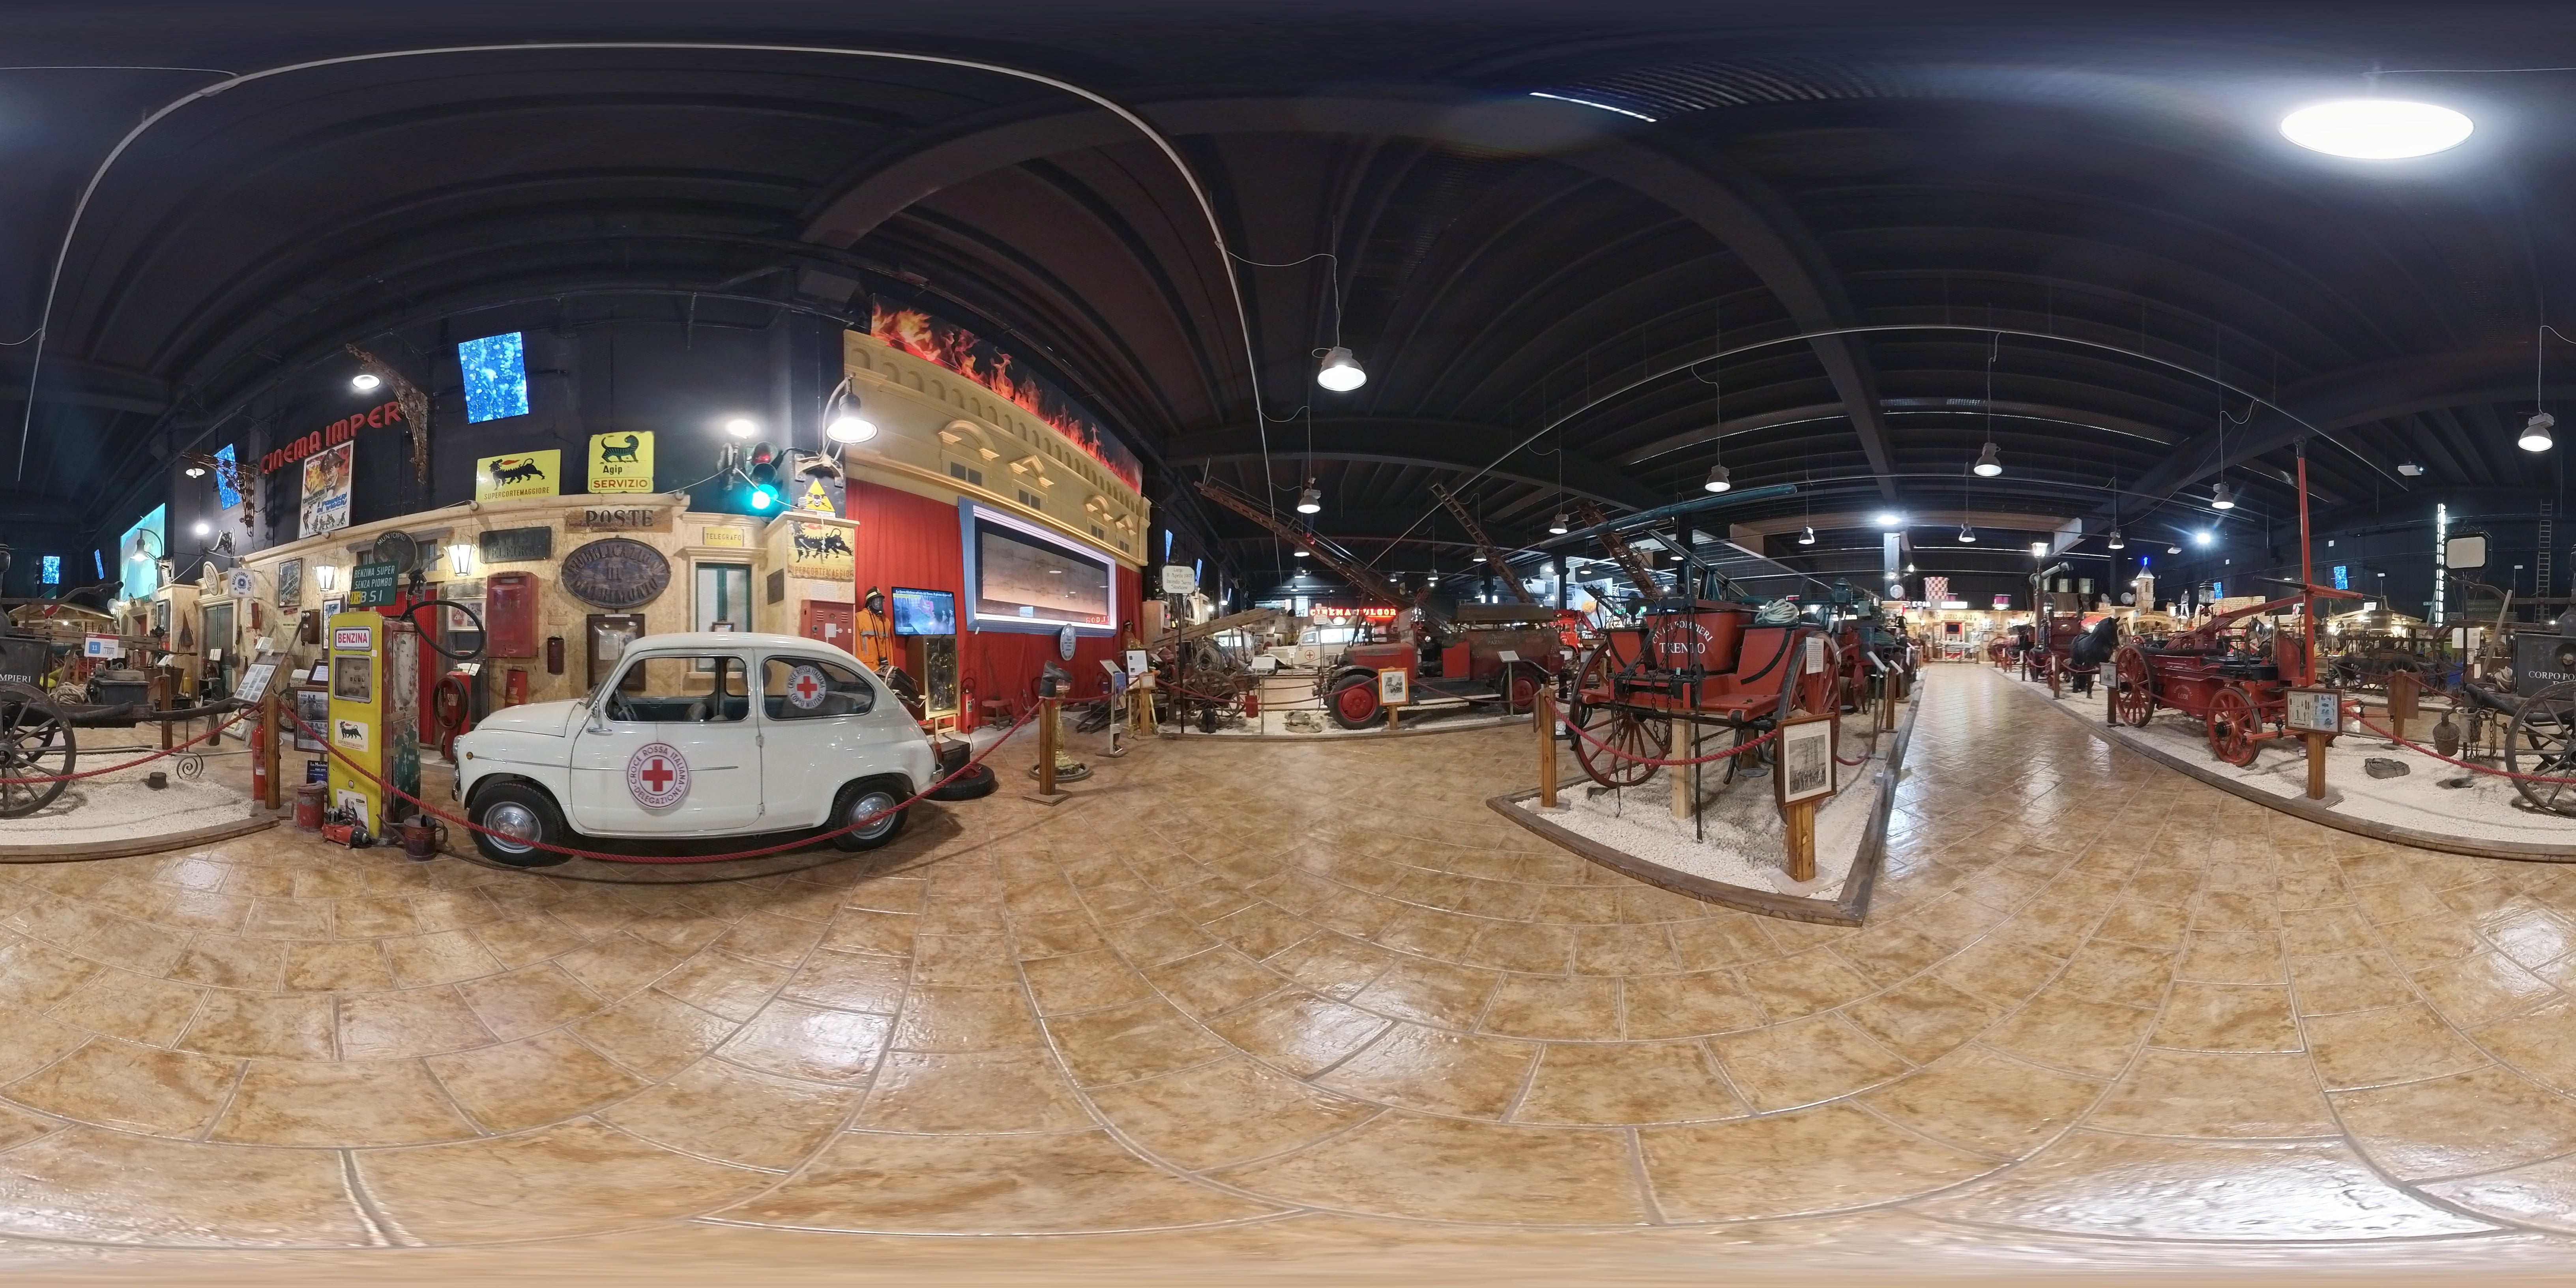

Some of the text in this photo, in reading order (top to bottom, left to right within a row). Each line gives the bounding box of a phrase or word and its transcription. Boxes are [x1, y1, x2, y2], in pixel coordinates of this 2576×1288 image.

[260, 431, 322, 474] CINEMA
[603, 465, 622, 475] Agip
[593, 479, 648, 488] SERVIZIO
[484, 487, 550, 500] SUPERCORTEMAGGIORE
[586, 509, 653, 527] POSTE
[377, 532, 406, 546] MUNICIPIO
[232, 571, 248, 585] RICEVITORIA
[354, 565, 395, 578] BENZINA SUPER
[354, 577, 392, 589] SENZA PIOMBO
[338, 633, 367, 643] BENZINA
[1674, 621, 1713, 642] POMIERI
[788, 674, 797, 689] CROCE
[2529, 671, 2561, 680] CORPO
[630, 746, 686, 785] CROCE ROSSA ITALIANA
[634, 787, 682, 804] DELEGAZIONE
